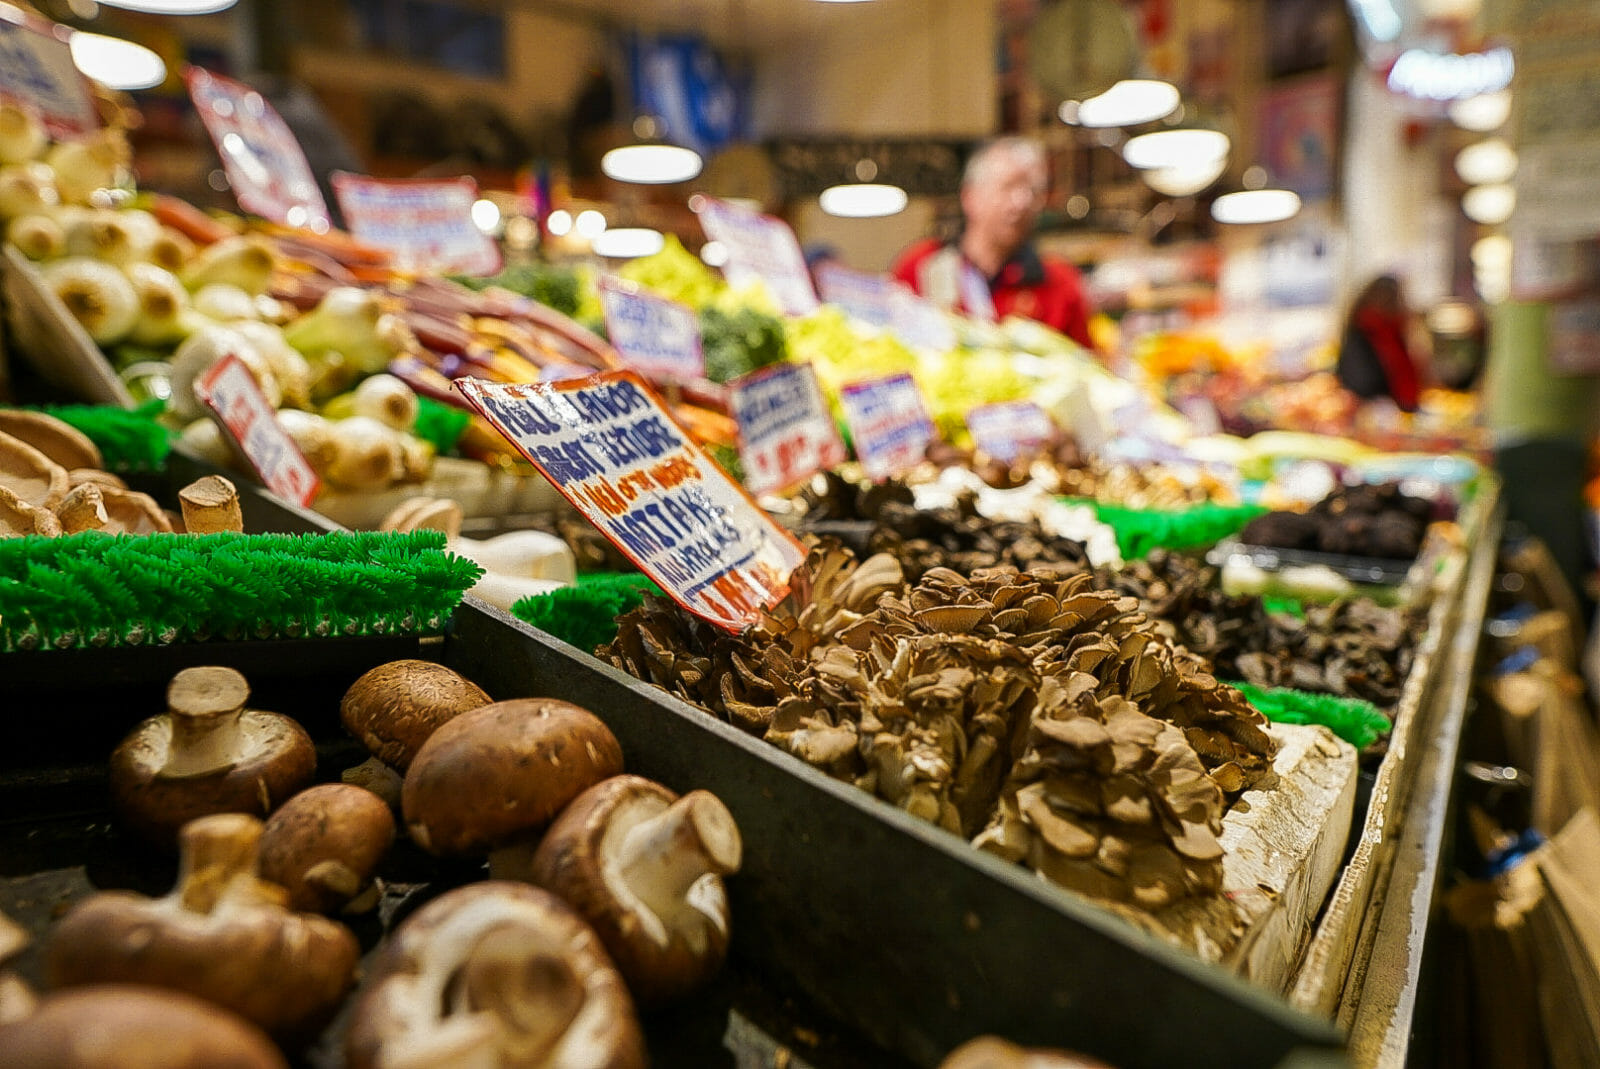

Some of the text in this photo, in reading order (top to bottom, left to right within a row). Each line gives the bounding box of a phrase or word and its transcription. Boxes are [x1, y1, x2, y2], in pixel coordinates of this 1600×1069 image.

[547, 380, 651, 427] LAVOR
[528, 416, 681, 487] GREAT TEXTURE
